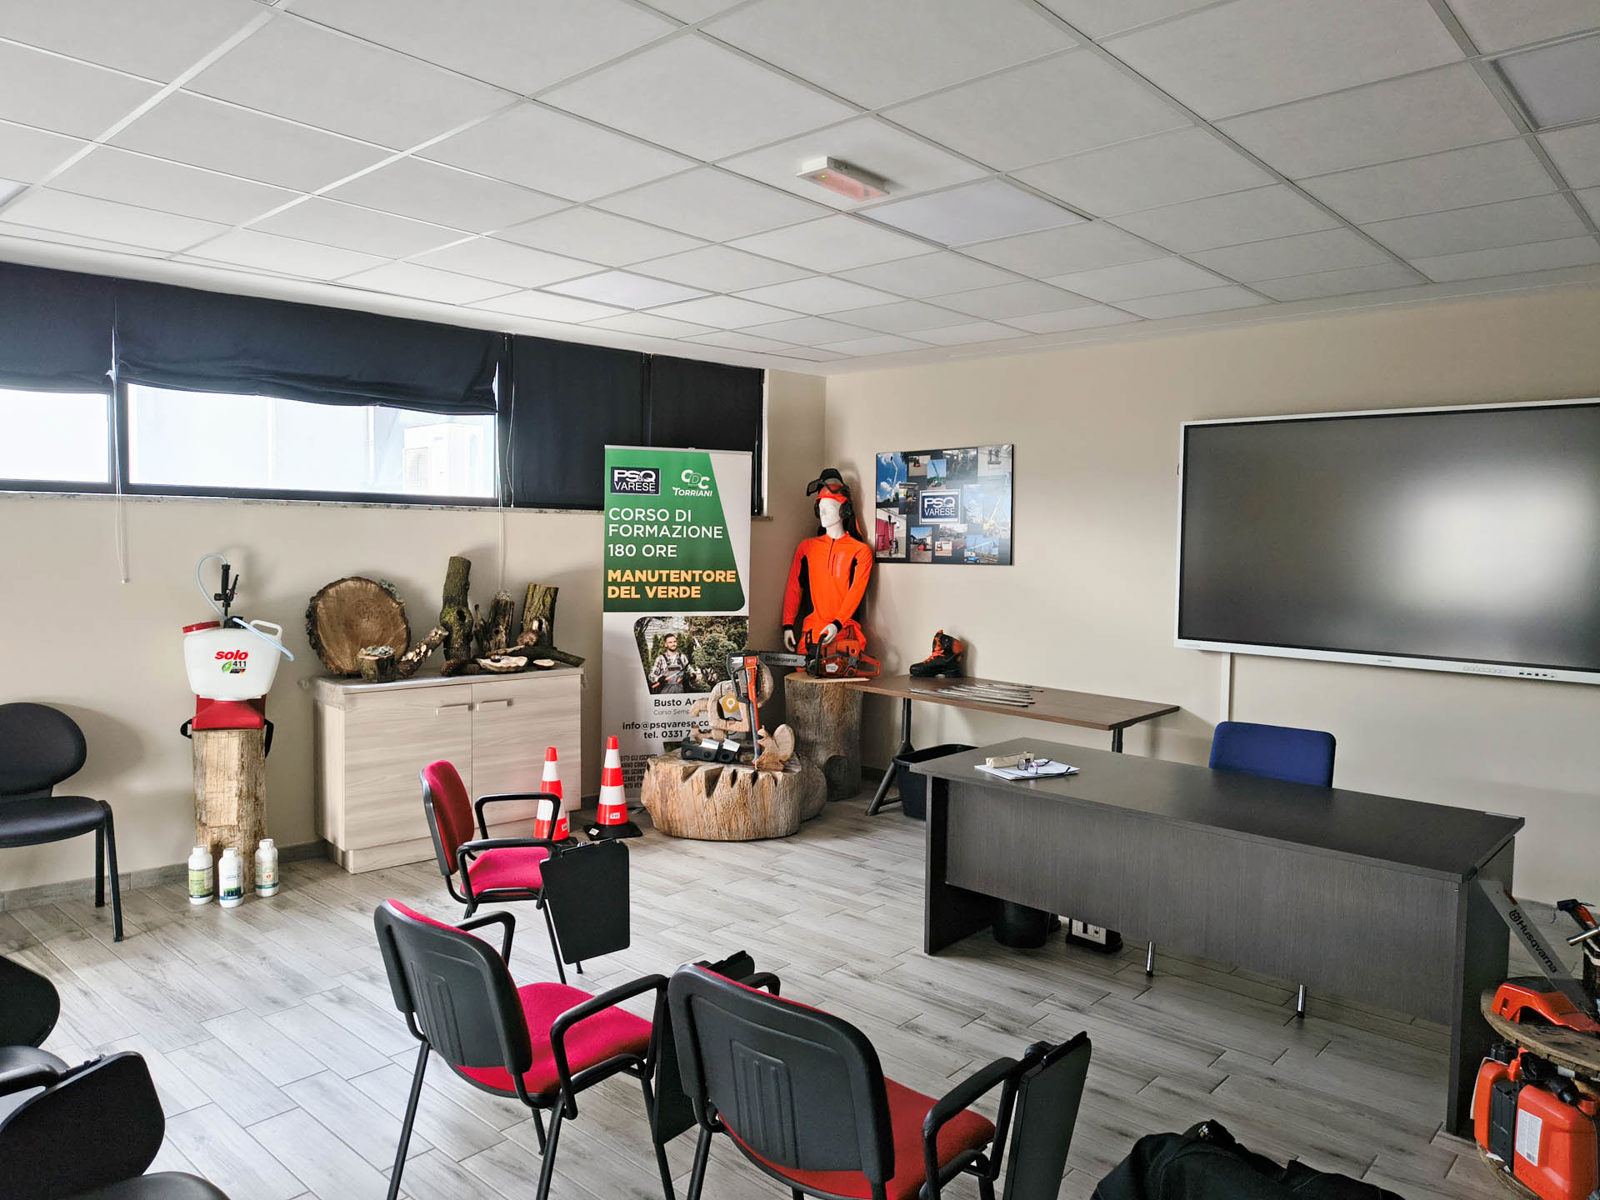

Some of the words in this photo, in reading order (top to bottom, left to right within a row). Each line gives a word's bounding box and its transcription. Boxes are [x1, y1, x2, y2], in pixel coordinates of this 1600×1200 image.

[613, 469, 656, 482] PSQ
[614, 482, 656, 492] VARESE
[672, 486, 713, 497] TORRIANI
[608, 507, 670, 522] CORSO
[675, 509, 692, 522] DI
[924, 508, 955, 516] VARESE
[608, 524, 723, 538] FORMAZIONE
[608, 543, 637, 557] 180
[642, 544, 678, 558] ORE
[607, 569, 736, 583] MANUTENTORE
[607, 586, 641, 598] DEL
[645, 586, 702, 598] VERDE
[214, 649, 249, 661] solo
[654, 699, 682, 707] Busto
[644, 731, 659, 739] tel.
[661, 730, 683, 738] 0331
[1517, 919, 1558, 973] Husqvarna
